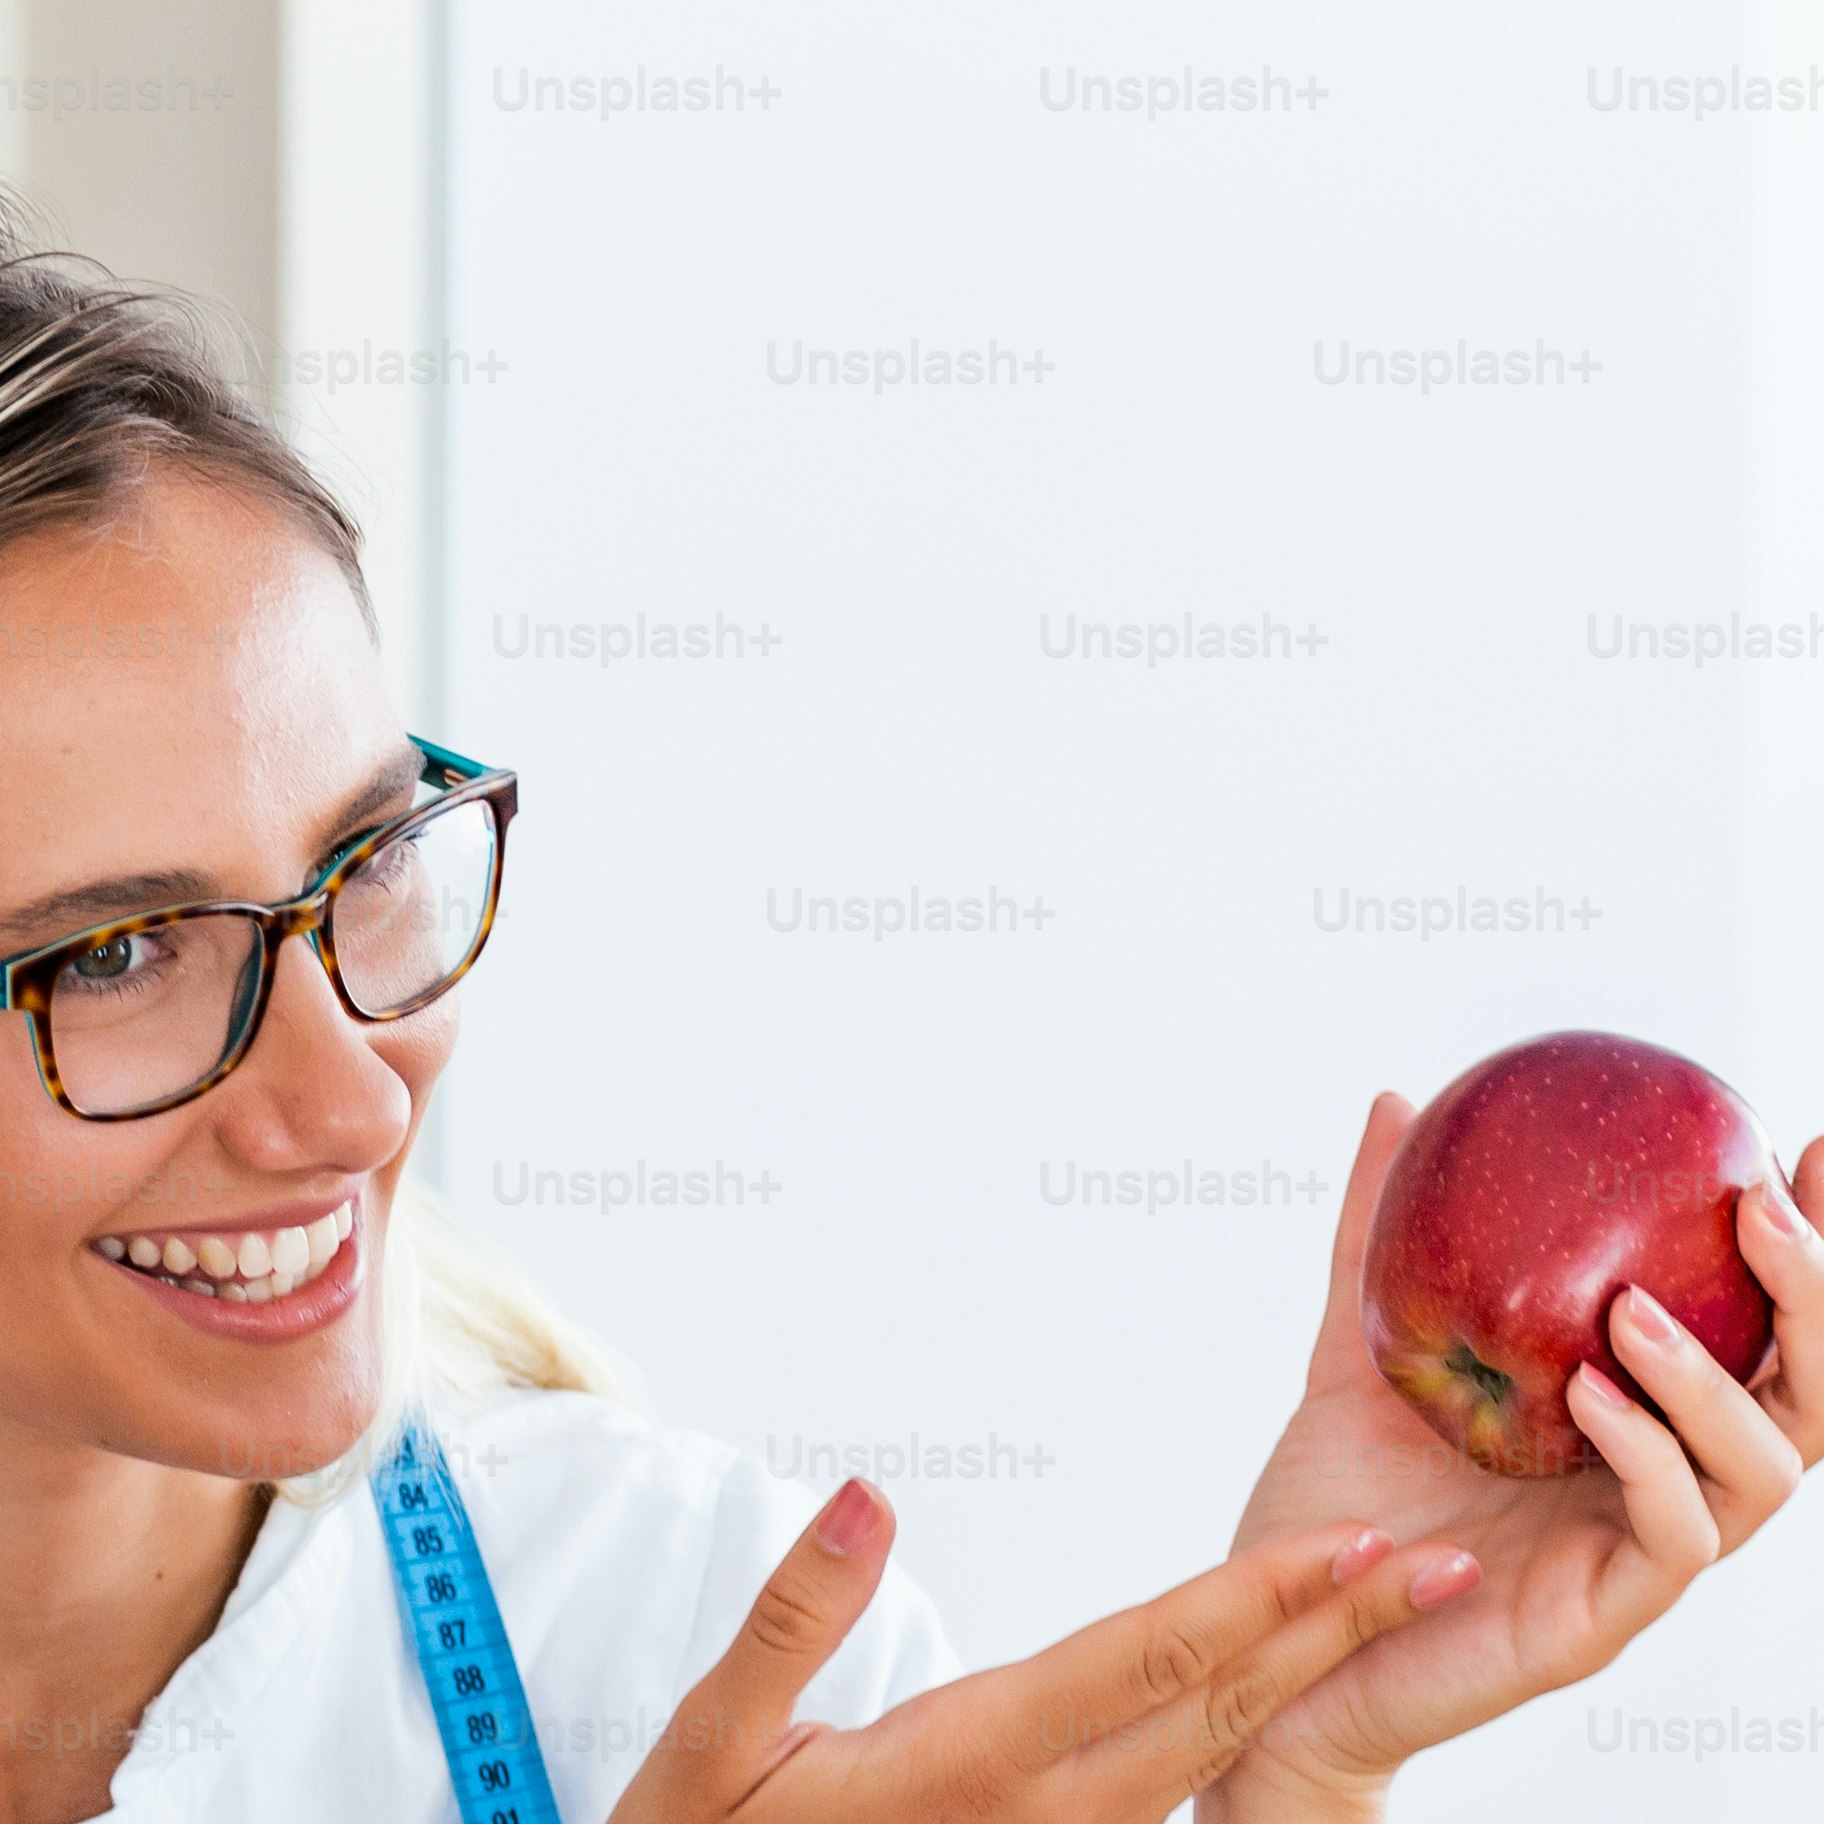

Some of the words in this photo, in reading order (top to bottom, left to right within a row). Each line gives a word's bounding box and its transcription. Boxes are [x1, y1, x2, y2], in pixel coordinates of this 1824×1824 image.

[412, 1526, 443, 1555] 85
[425, 1573, 456, 1603] 86
[439, 1619, 466, 1649] 87
[452, 1664, 485, 1695] 88
[467, 1711, 497, 1743] 89
[479, 1759, 510, 1791] 90
